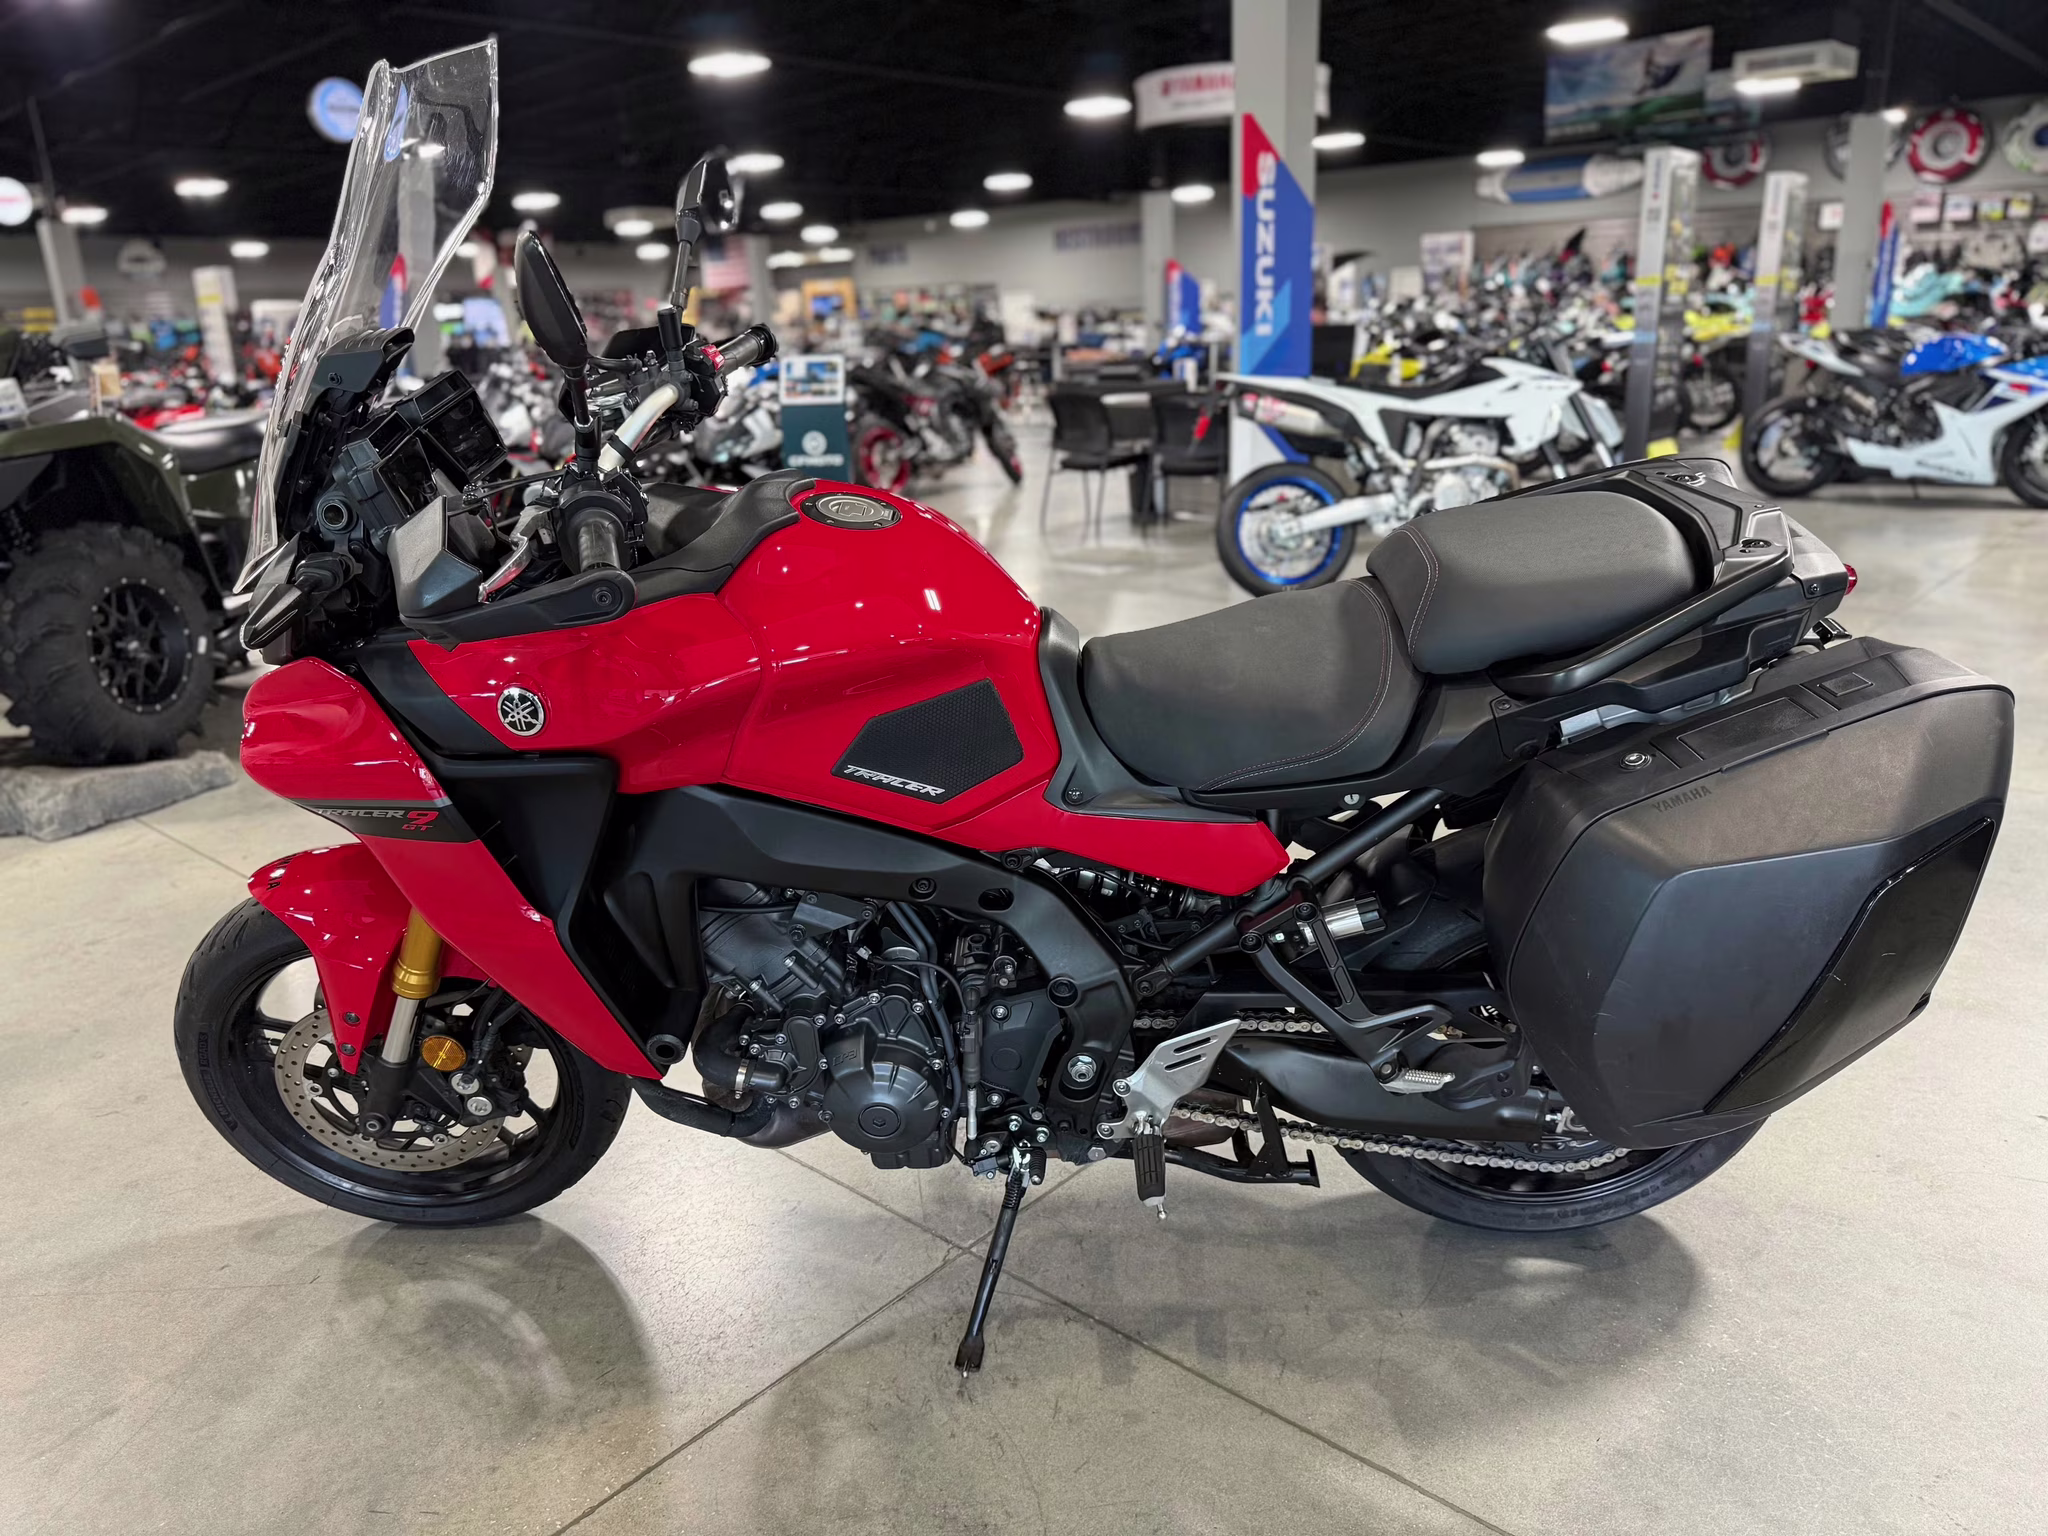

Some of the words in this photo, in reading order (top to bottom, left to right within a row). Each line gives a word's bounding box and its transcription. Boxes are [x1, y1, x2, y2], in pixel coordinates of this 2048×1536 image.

[1255, 150, 1277, 336] SUZUKI
[843, 765, 945, 797] TRACER
[1652, 785, 1712, 813] YAMAHA
[315, 808, 405, 819] TRACER
[407, 810, 439, 825] 9
[402, 823, 433, 831] GT
